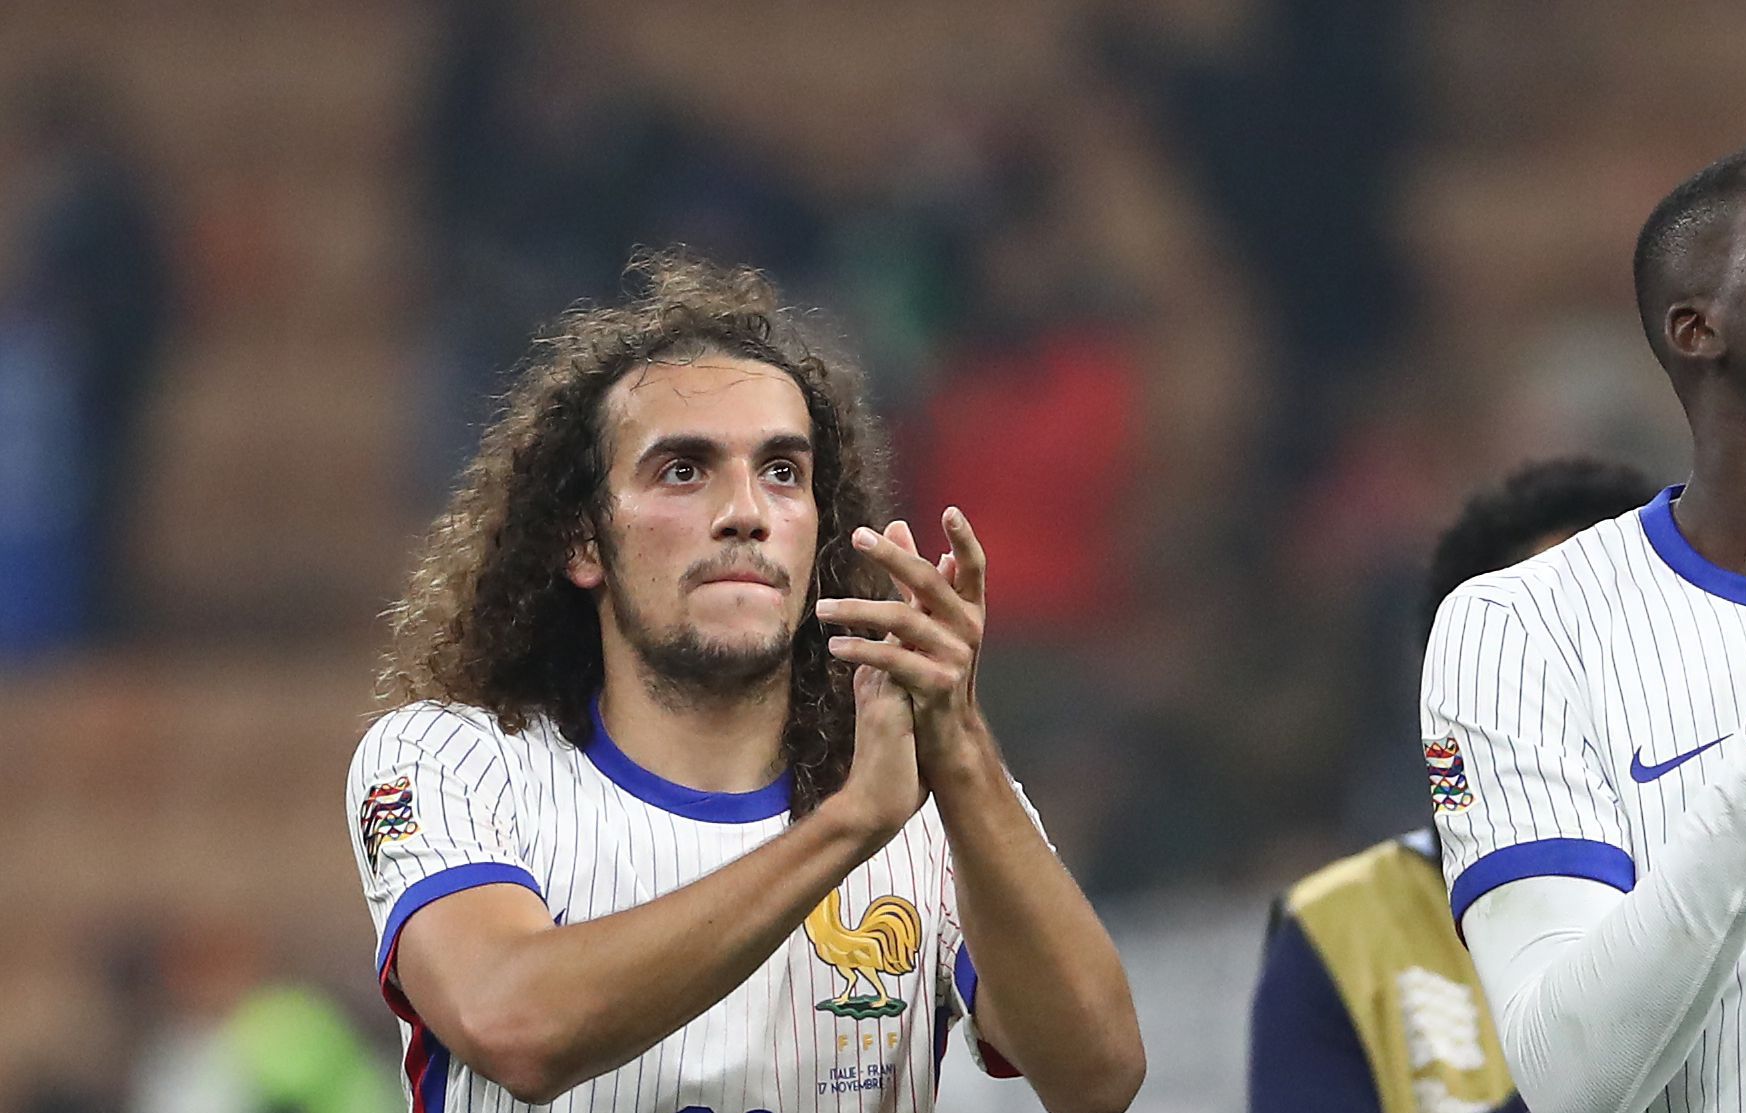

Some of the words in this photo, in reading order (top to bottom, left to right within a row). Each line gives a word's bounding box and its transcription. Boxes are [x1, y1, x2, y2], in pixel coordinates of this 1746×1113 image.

[830, 1066, 856, 1080] ITALIE
[867, 1063, 894, 1076] FRAN
[817, 1082, 827, 1095] 17
